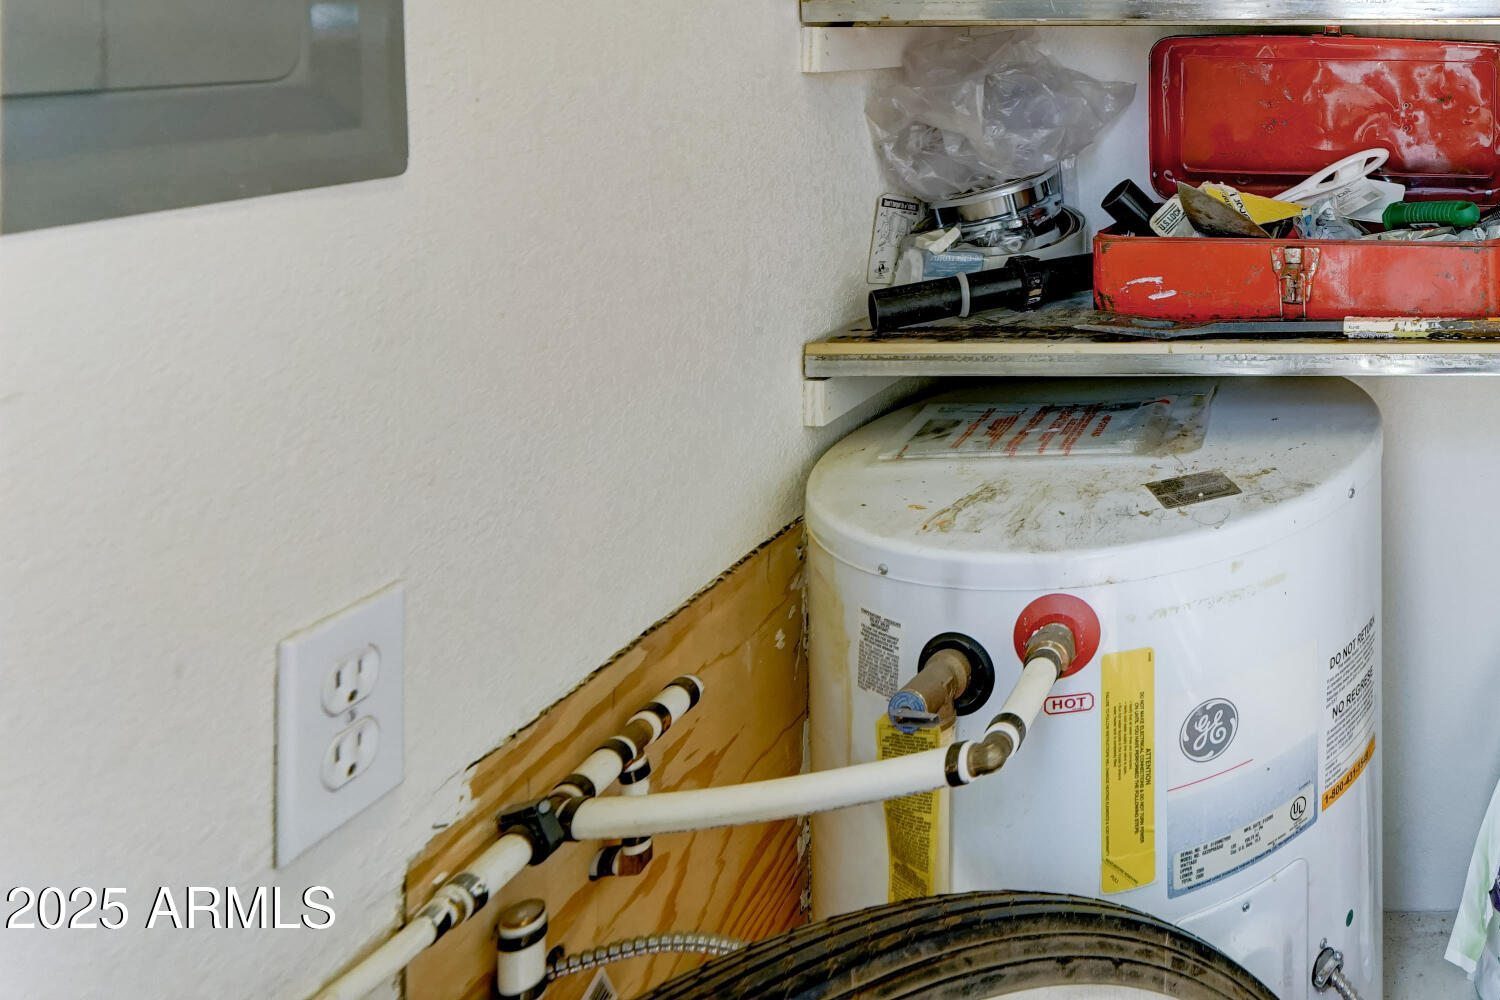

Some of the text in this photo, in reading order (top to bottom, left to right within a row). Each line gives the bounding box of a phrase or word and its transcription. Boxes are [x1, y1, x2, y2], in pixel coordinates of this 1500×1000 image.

[1329, 652, 1341, 670] DO
[1342, 638, 1356, 658] NOT
[1052, 697, 1087, 711] HOT
[1332, 700, 1345, 720] NO
